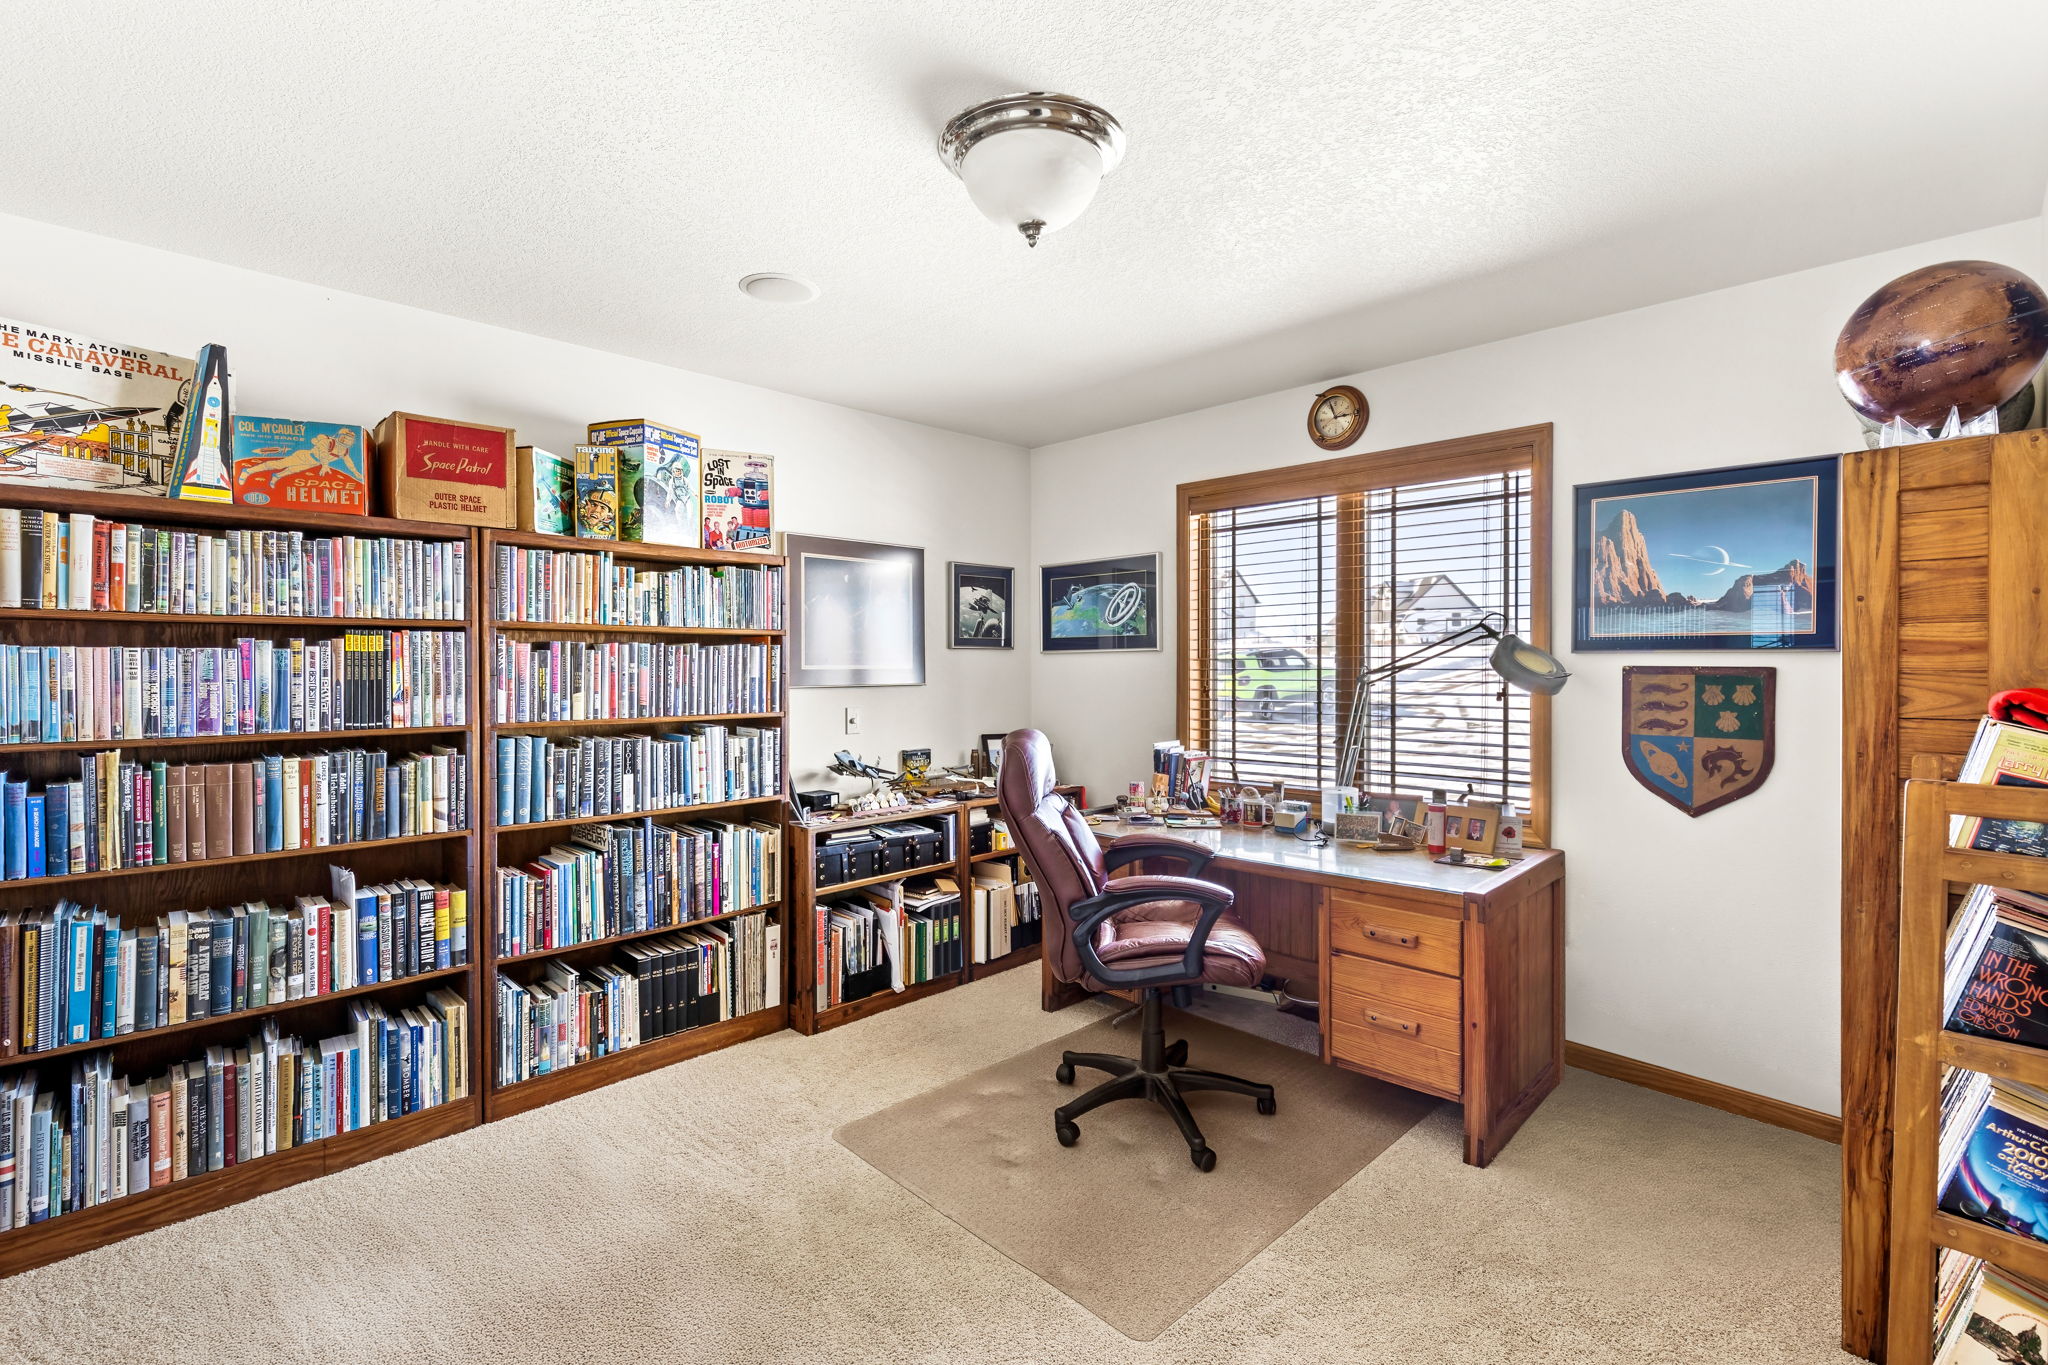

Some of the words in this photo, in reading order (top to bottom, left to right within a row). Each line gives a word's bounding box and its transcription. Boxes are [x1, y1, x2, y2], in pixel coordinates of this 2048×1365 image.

[13, 350, 83, 370] MISSILE
[91, 364, 133, 380] BASE
[28, 337, 184, 382] CANAVERAL
[453, 443, 470, 451] WITH
[472, 446, 489, 454] CARE
[420, 452, 456, 474] Space
[455, 457, 493, 476] Patrol
[707, 458, 731, 472] LOST
[286, 486, 363, 505] HELMET
[293, 478, 357, 491] SPACE
[429, 501, 458, 511] PLASTIC
[460, 504, 488, 514] HELMET
[434, 492, 457, 502] OUTER
[459, 495, 482, 504] SPACE
[704, 495, 734, 504] ROBOT
[597, 767, 606, 803] MOON
[330, 772, 338, 826] Rickenbacker
[381, 918, 390, 944] MISSION
[420, 934, 435, 964] VICTORY
[199, 953, 209, 972] FEW
[1984, 950, 2002, 969] IN
[2004, 956, 2038, 982] THE
[188, 954, 198, 996] CAPTAINS
[199, 972, 209, 1000] GREAT
[1968, 980, 2032, 1017] HANDS
[1963, 997, 2016, 1025] EDWARD
[1958, 1010, 2021, 1040] GIBSON
[131, 1132, 139, 1148] Right
[140, 1119, 149, 1137] Tom
[1985, 1122, 2030, 1146] Arthur
[36, 1132, 44, 1151] FIRST
[140, 1137, 149, 1159] Wolfe
[36, 1152, 44, 1179] FLIGHT
[1996, 1152, 2048, 1180] odyssey
[2008, 1164, 2034, 1180] two
